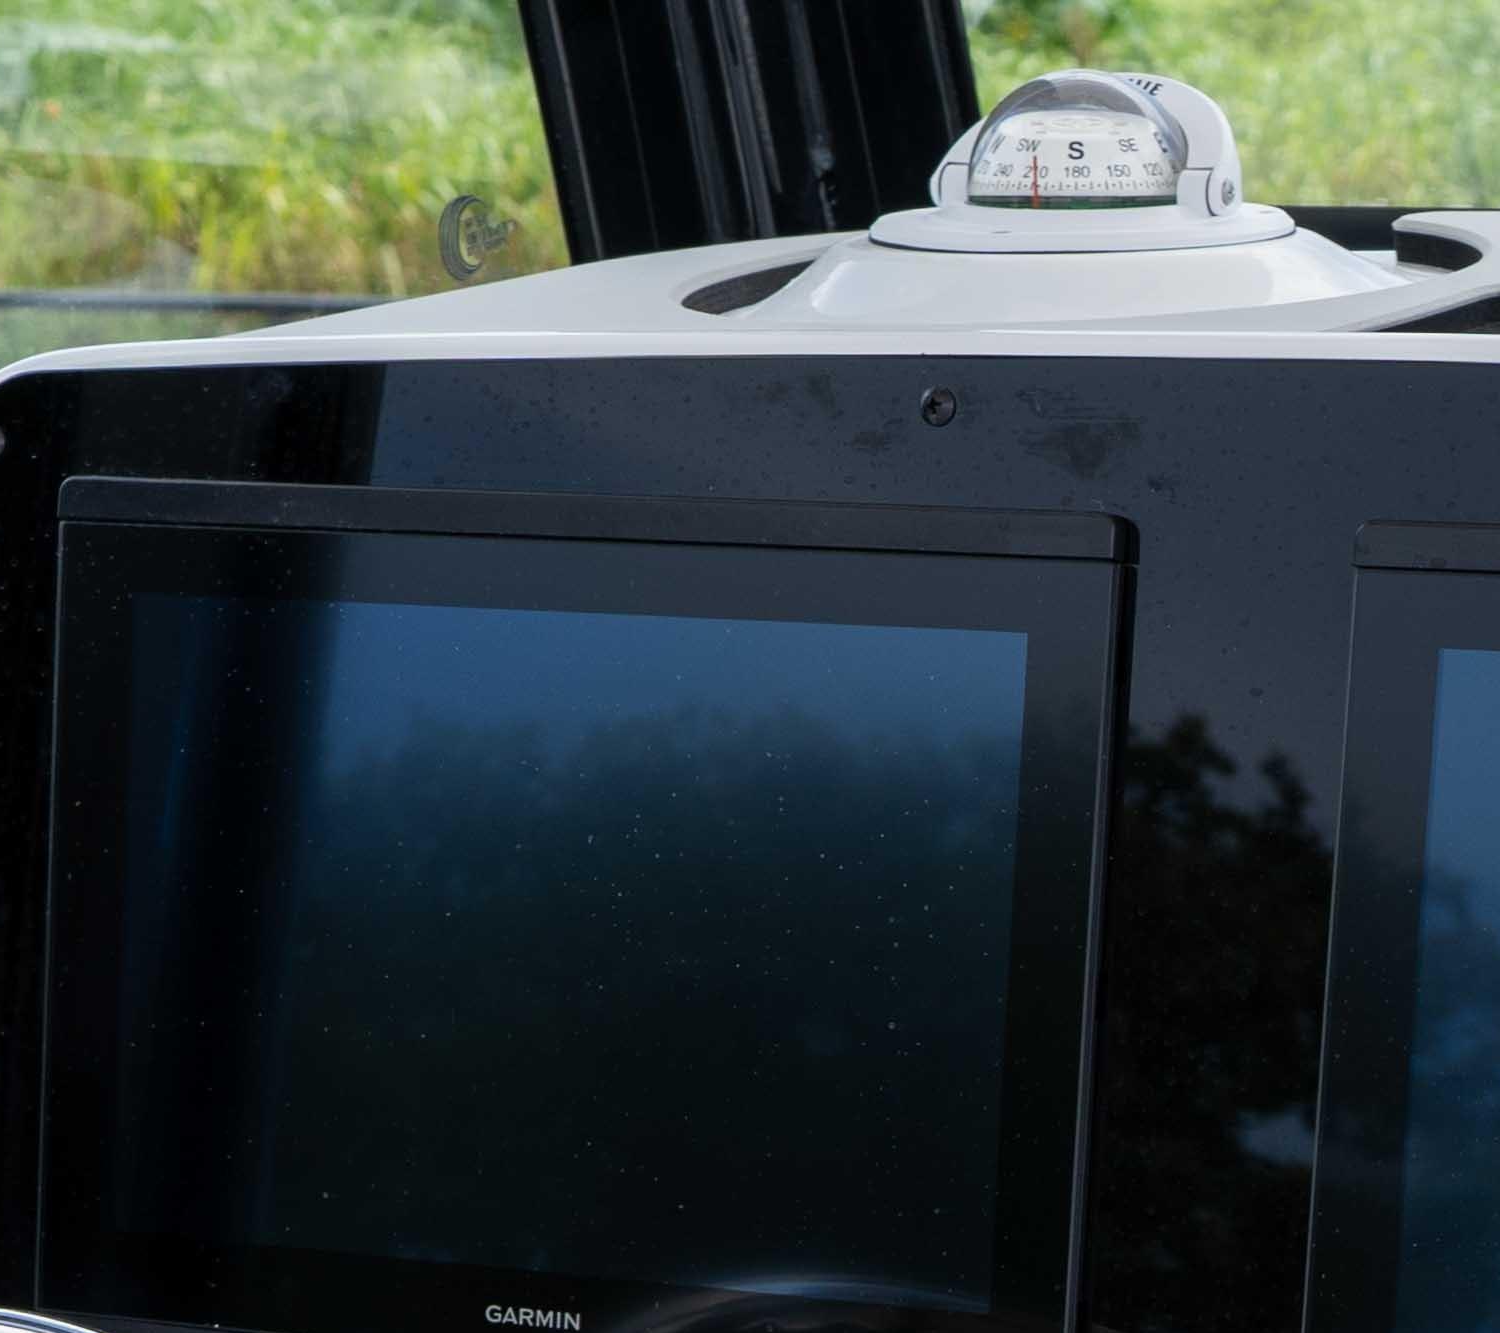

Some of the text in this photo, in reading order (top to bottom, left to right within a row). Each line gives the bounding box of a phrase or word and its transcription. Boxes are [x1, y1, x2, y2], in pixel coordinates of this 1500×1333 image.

[1067, 141, 1085, 160] S
[1119, 138, 1139, 152] SE
[1064, 165, 1091, 178] 180
[1107, 165, 1132, 178] 150
[484, 1304, 581, 1332] GARMIN
